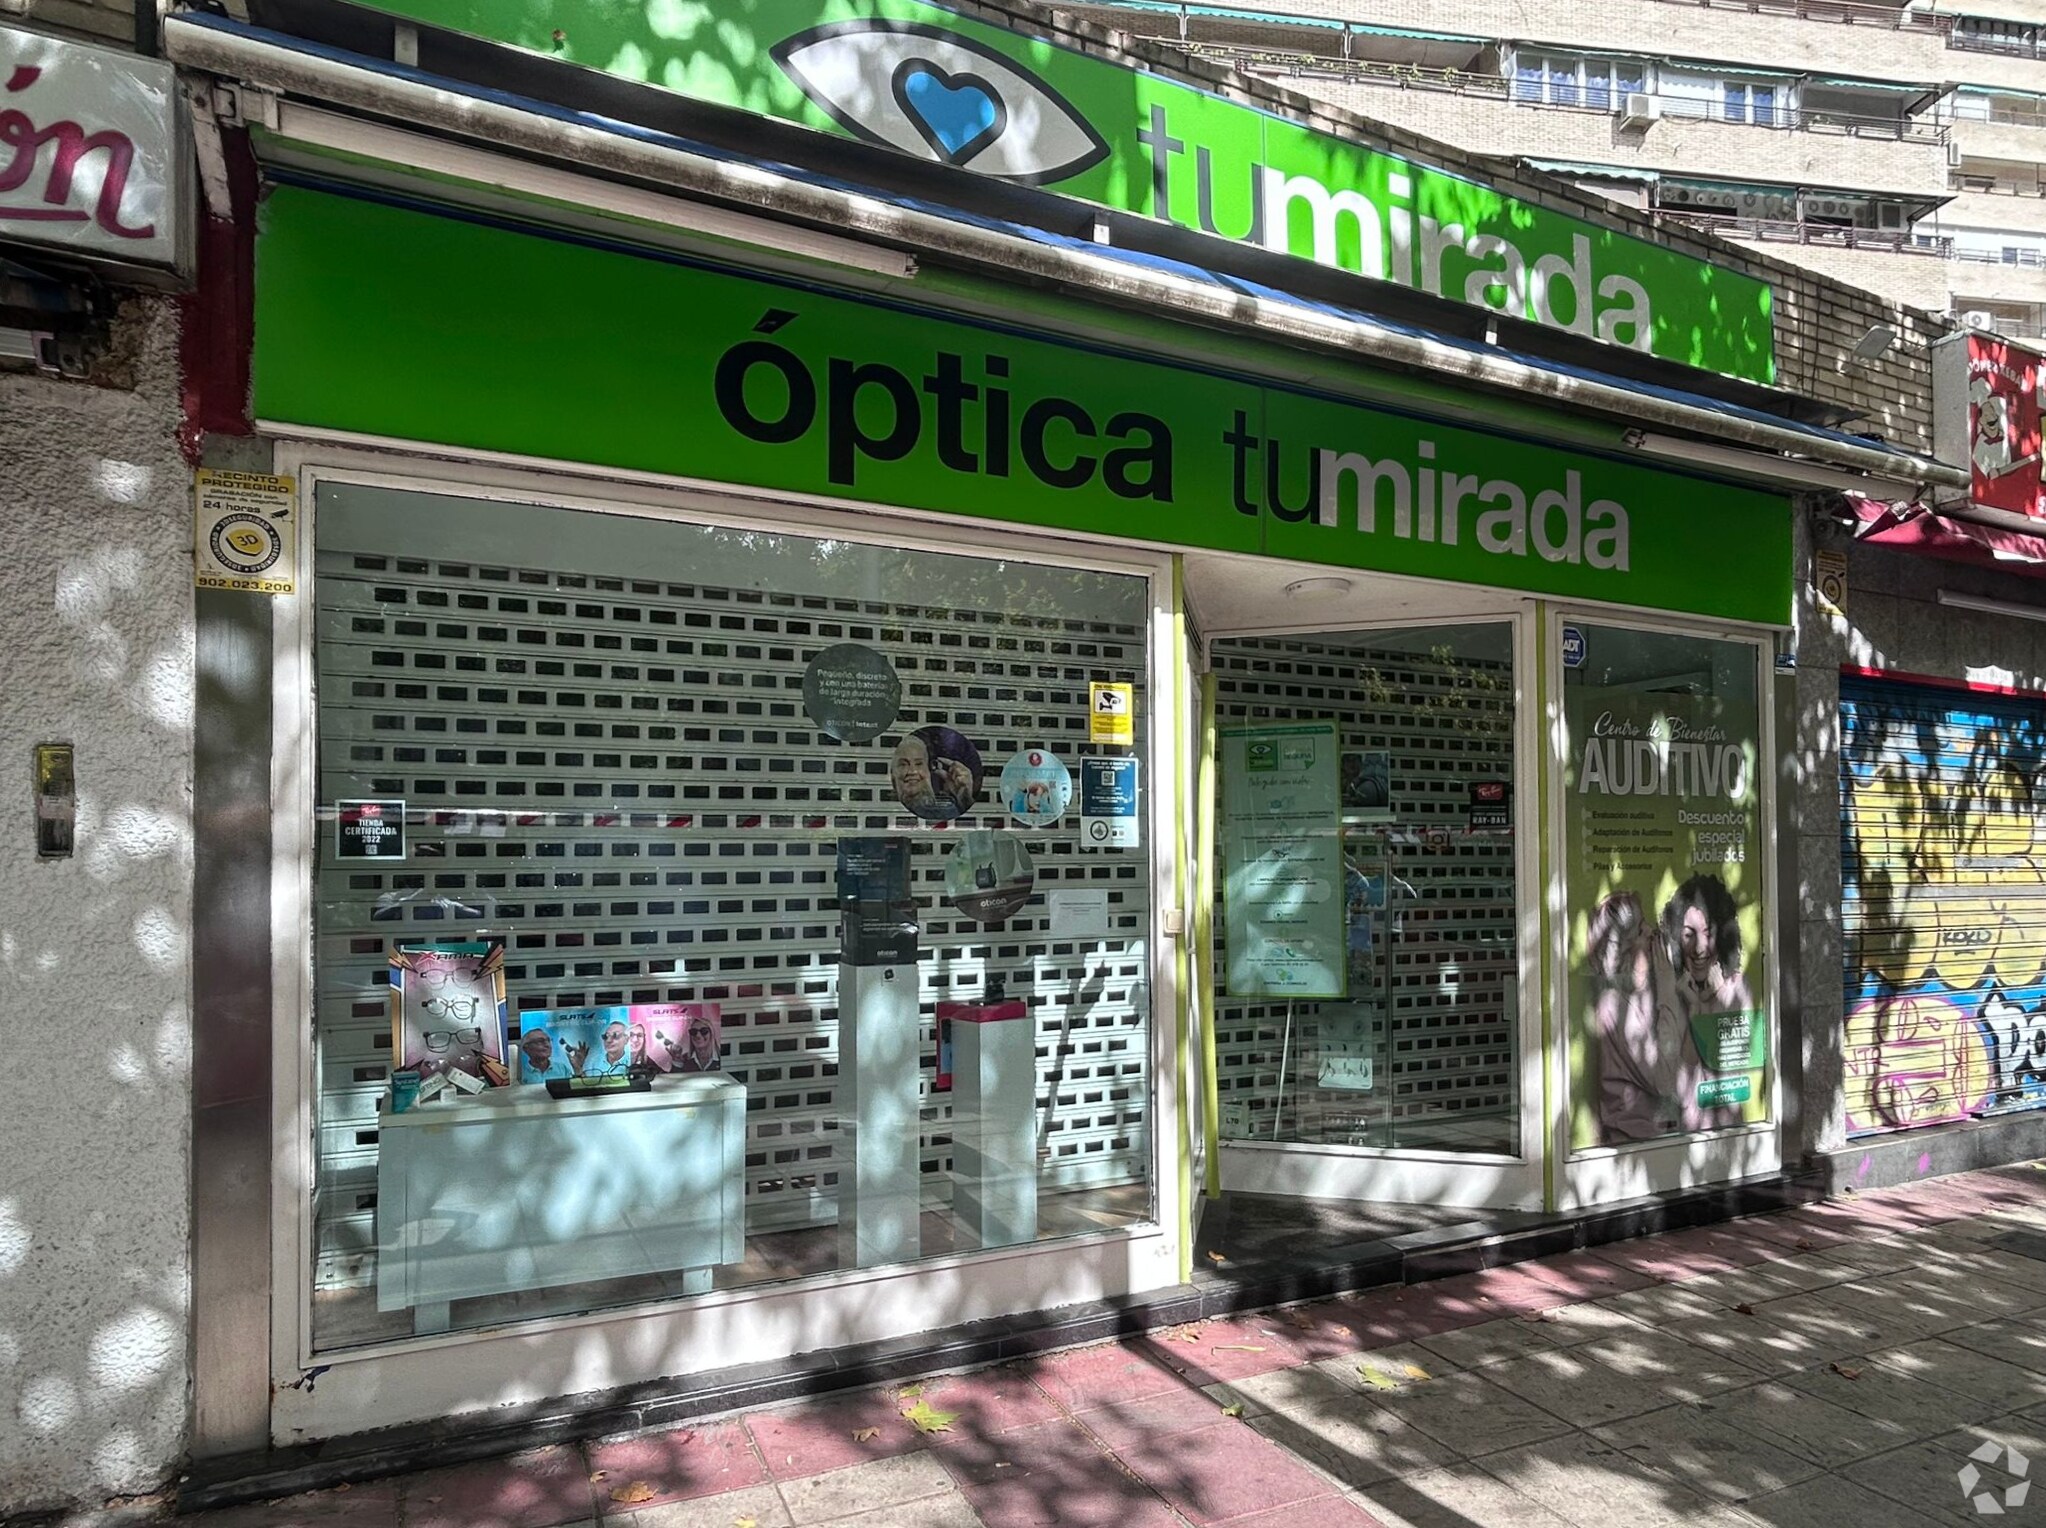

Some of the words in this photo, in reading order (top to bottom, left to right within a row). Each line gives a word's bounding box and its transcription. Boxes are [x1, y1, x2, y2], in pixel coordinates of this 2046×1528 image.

[1136, 104, 1652, 355] tumirada
[714, 308, 1174, 503] óptica
[1222, 408, 1631, 572] tumirada
[201, 478, 289, 494] PROTEGIDO
[210, 488, 262, 499] GRABACIÓN
[203, 500, 221, 509] 24
[226, 502, 261, 513] horas
[250, 498, 288, 506] seguridad
[236, 534, 259, 547] 3D
[198, 577, 292, 592] 902.023.200
[1563, 639, 1580, 652] ADT
[830, 688, 851, 698] larga
[1594, 710, 1641, 737] Centro
[1645, 719, 1662, 738] de
[1666, 717, 1728, 743] Bienestar
[1578, 737, 1746, 799] AUDITIVO
[359, 819, 384, 827] TIENDA
[1472, 816, 1507, 824] RAY-BAN
[1678, 809, 1745, 825] Descuento
[344, 826, 398, 836] CERTIFICADA
[1698, 828, 1745, 847] especial
[361, 835, 381, 844] 2022
[1692, 846, 1745, 866] jubilados
[980, 897, 1007, 908] oticon
[1717, 1015, 1750, 1027] PRUEBA
[1717, 1026, 1750, 1040] GRATIS
[1700, 1078, 1749, 1094] FINANCIACIÓN
[1714, 1093, 1737, 1104] TOTAL
